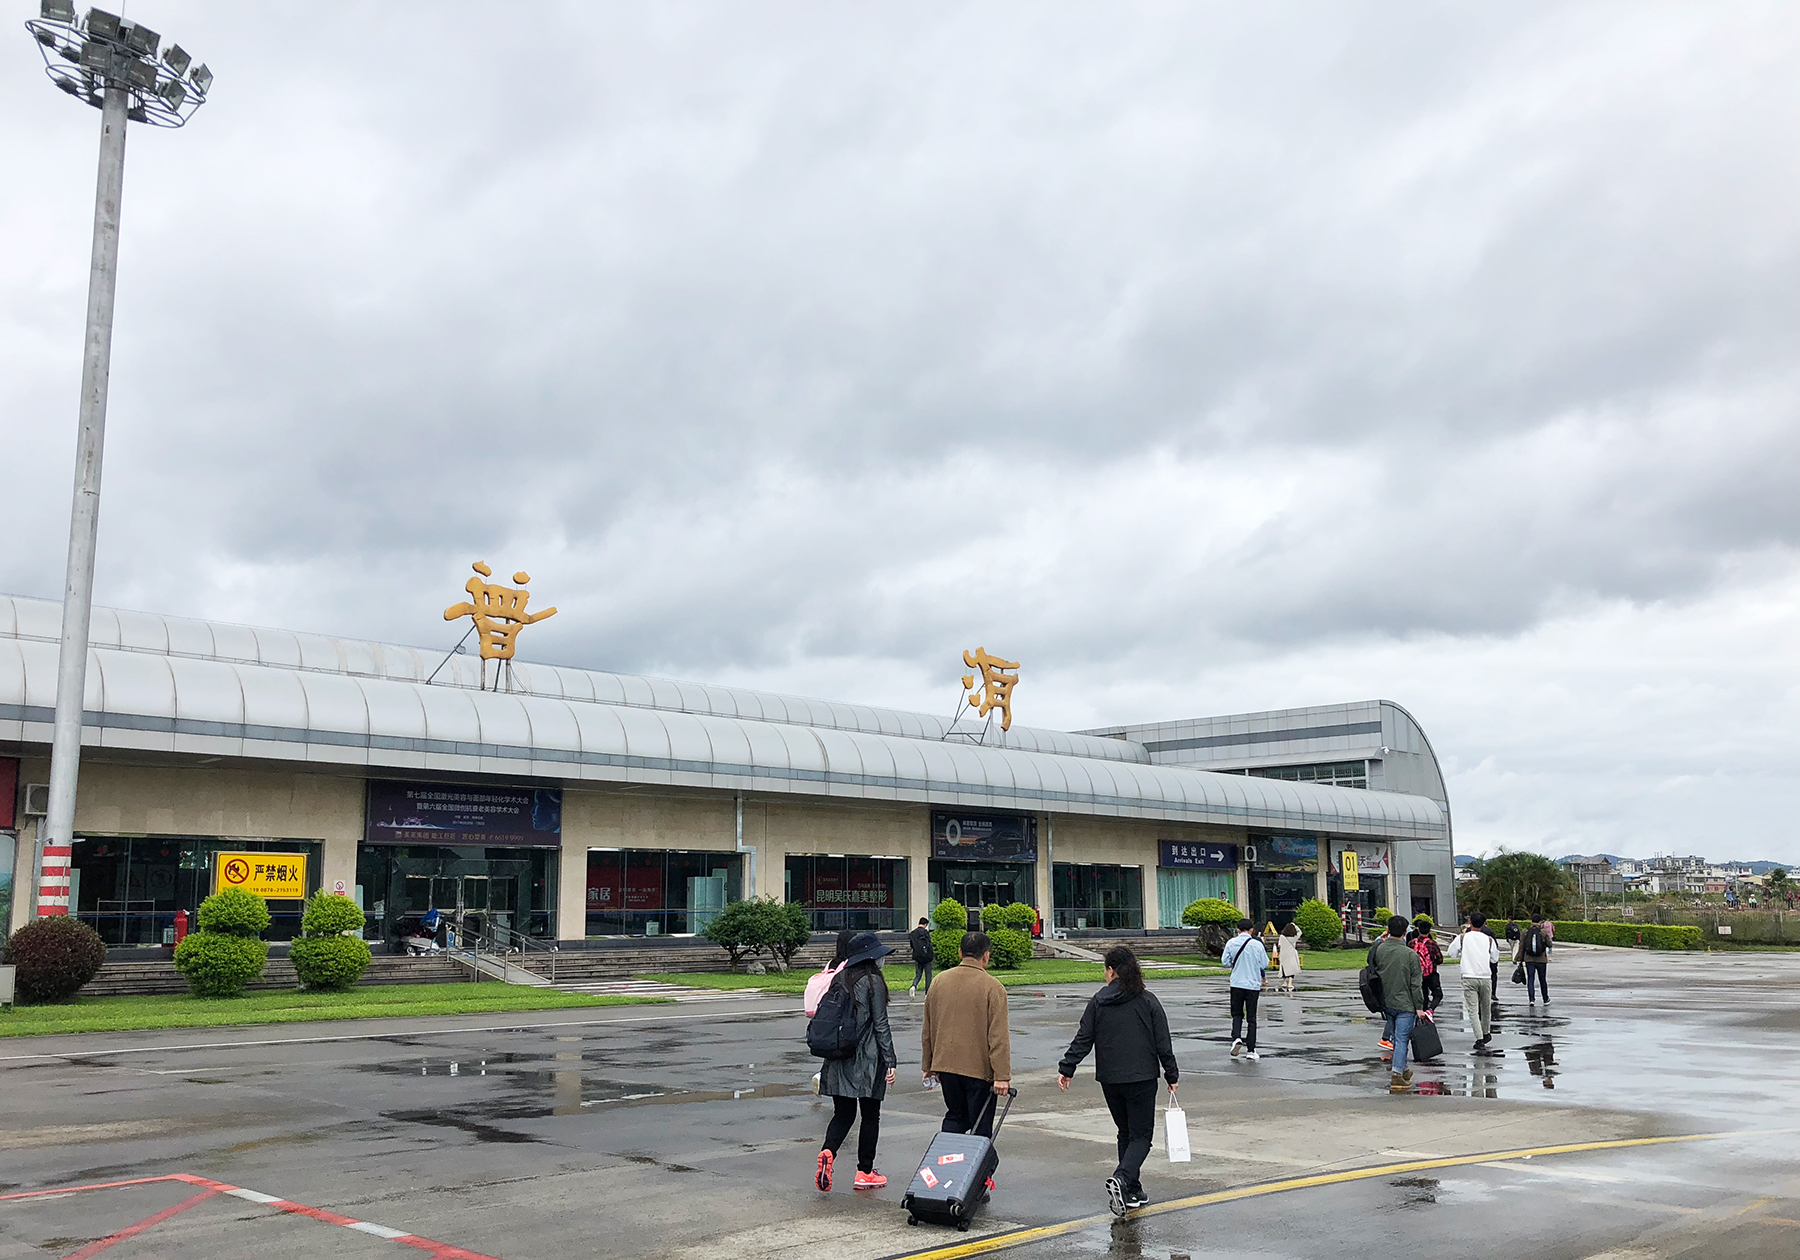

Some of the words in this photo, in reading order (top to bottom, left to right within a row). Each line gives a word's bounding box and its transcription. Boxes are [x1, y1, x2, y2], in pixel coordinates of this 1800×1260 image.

[444, 560, 558, 660] 普
[1171, 845, 1206, 857] 到达出口
[1345, 856, 1356, 872] 01
[253, 864, 299, 882] 严禁烟火
[587, 887, 611, 901] 家居
